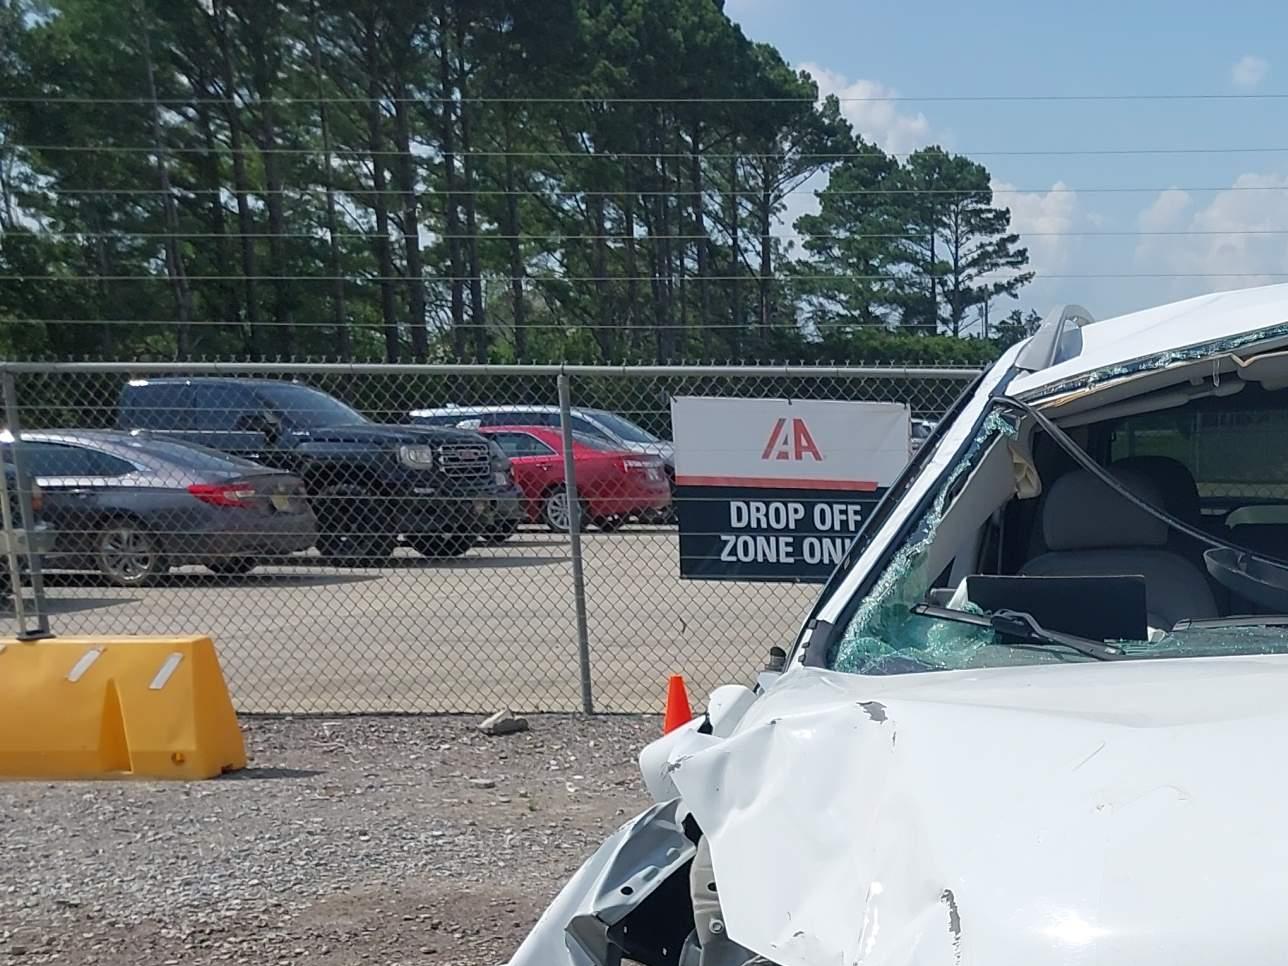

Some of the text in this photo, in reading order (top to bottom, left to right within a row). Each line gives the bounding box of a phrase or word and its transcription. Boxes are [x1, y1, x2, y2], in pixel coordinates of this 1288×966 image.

[730, 501, 862, 532] DROP OFF
[720, 536, 795, 564] ZONE
